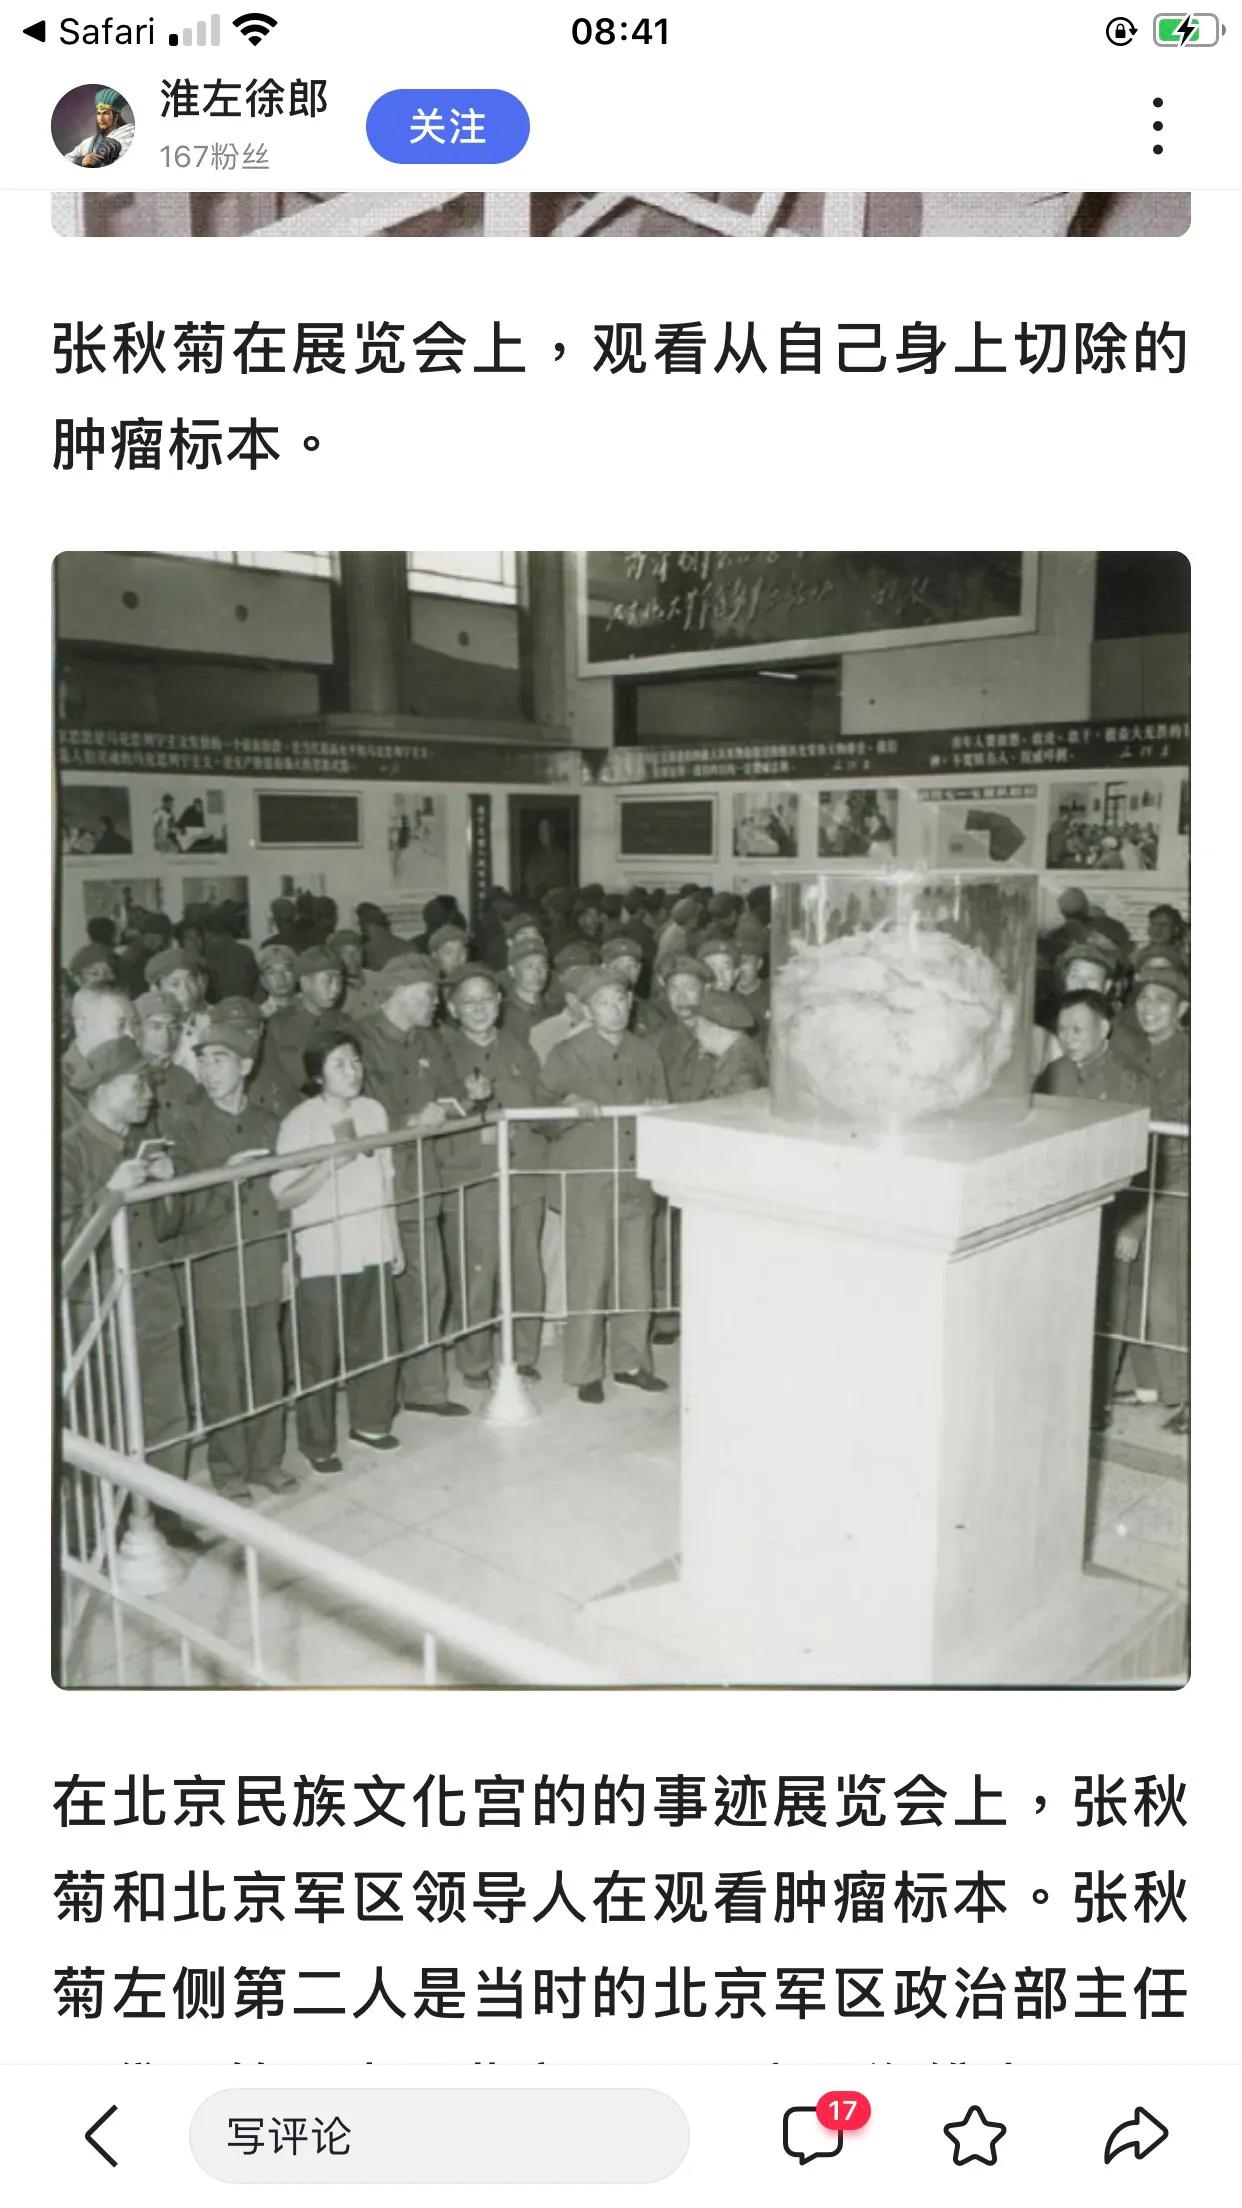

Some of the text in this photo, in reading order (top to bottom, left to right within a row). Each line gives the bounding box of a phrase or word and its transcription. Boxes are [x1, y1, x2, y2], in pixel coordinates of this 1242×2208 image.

[59, 16, 155, 46] Safari
[571, 17, 668, 46] 08:41
[160, 77, 328, 119] 淮左徐郎
[409, 107, 486, 145] 关注
[160, 142, 270, 171] 167粉丝
[53, 320, 1186, 375] 张秋菊在展览会上，观看从自己身上切除的
[52, 416, 321, 471] 肿瘤标本。
[52, 1773, 1188, 1828] 在北京民族文化宫的的事迹展览会上，张秋
[52, 1868, 1188, 1925] 菊和北京军区领导人在观看肿瘤标本。张秋
[52, 1965, 1188, 2021] 菊左侧第二人是当时的北京军区政治部主任
[829, 2100, 857, 2121] 17
[227, 2115, 352, 2156] 写评论
